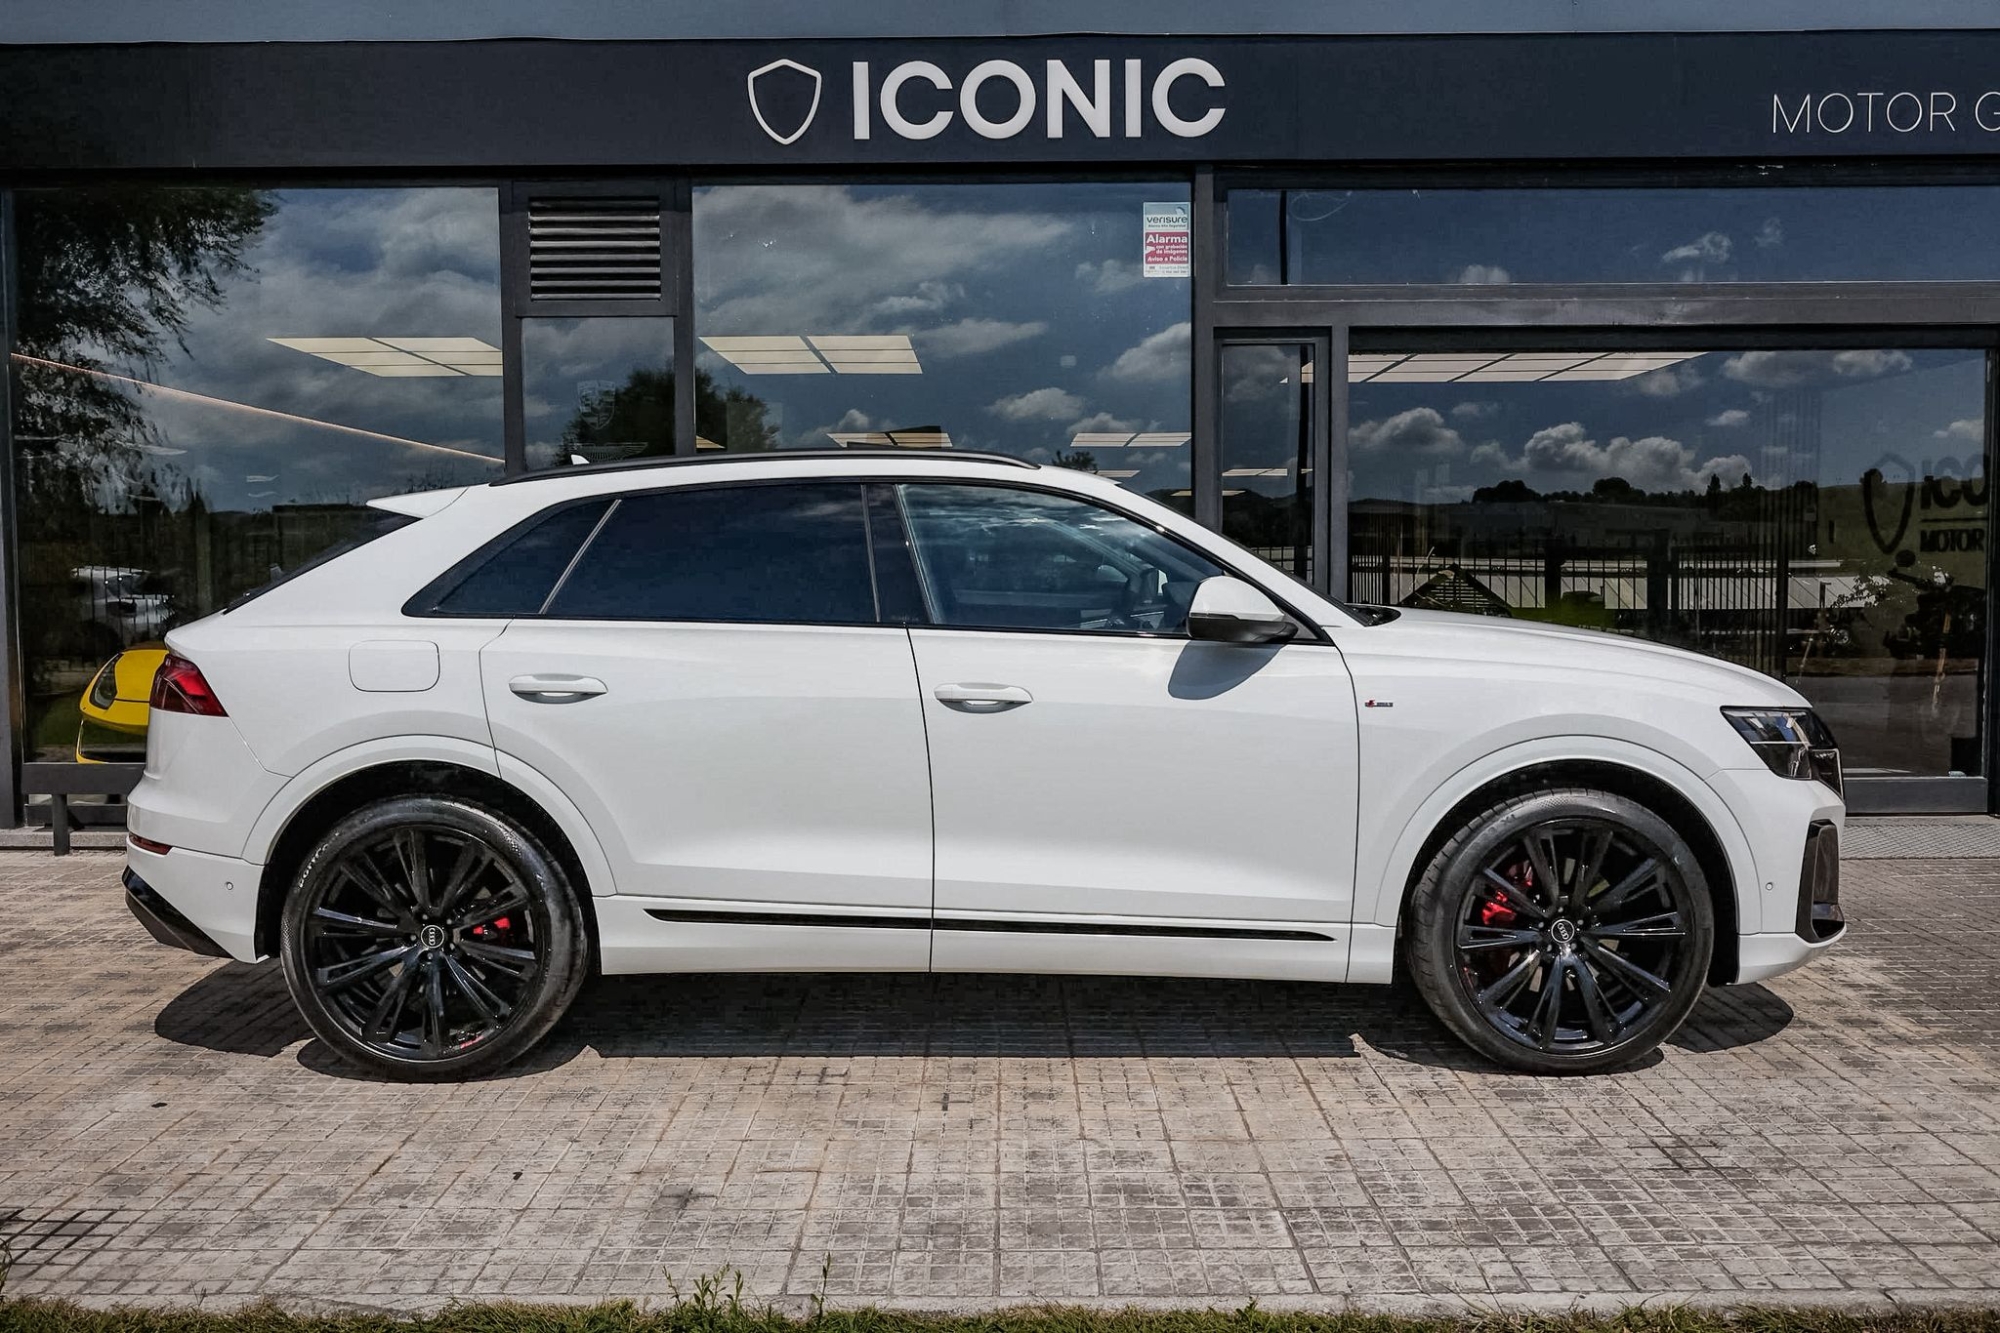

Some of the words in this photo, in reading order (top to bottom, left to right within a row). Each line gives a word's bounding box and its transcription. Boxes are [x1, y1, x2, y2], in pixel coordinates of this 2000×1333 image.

[852, 57, 1227, 140] ICONIC
[1772, 91, 1957, 134] MOTOR
[1146, 234, 1188, 243] Alarma
[1920, 528, 1985, 552] MOTOR
